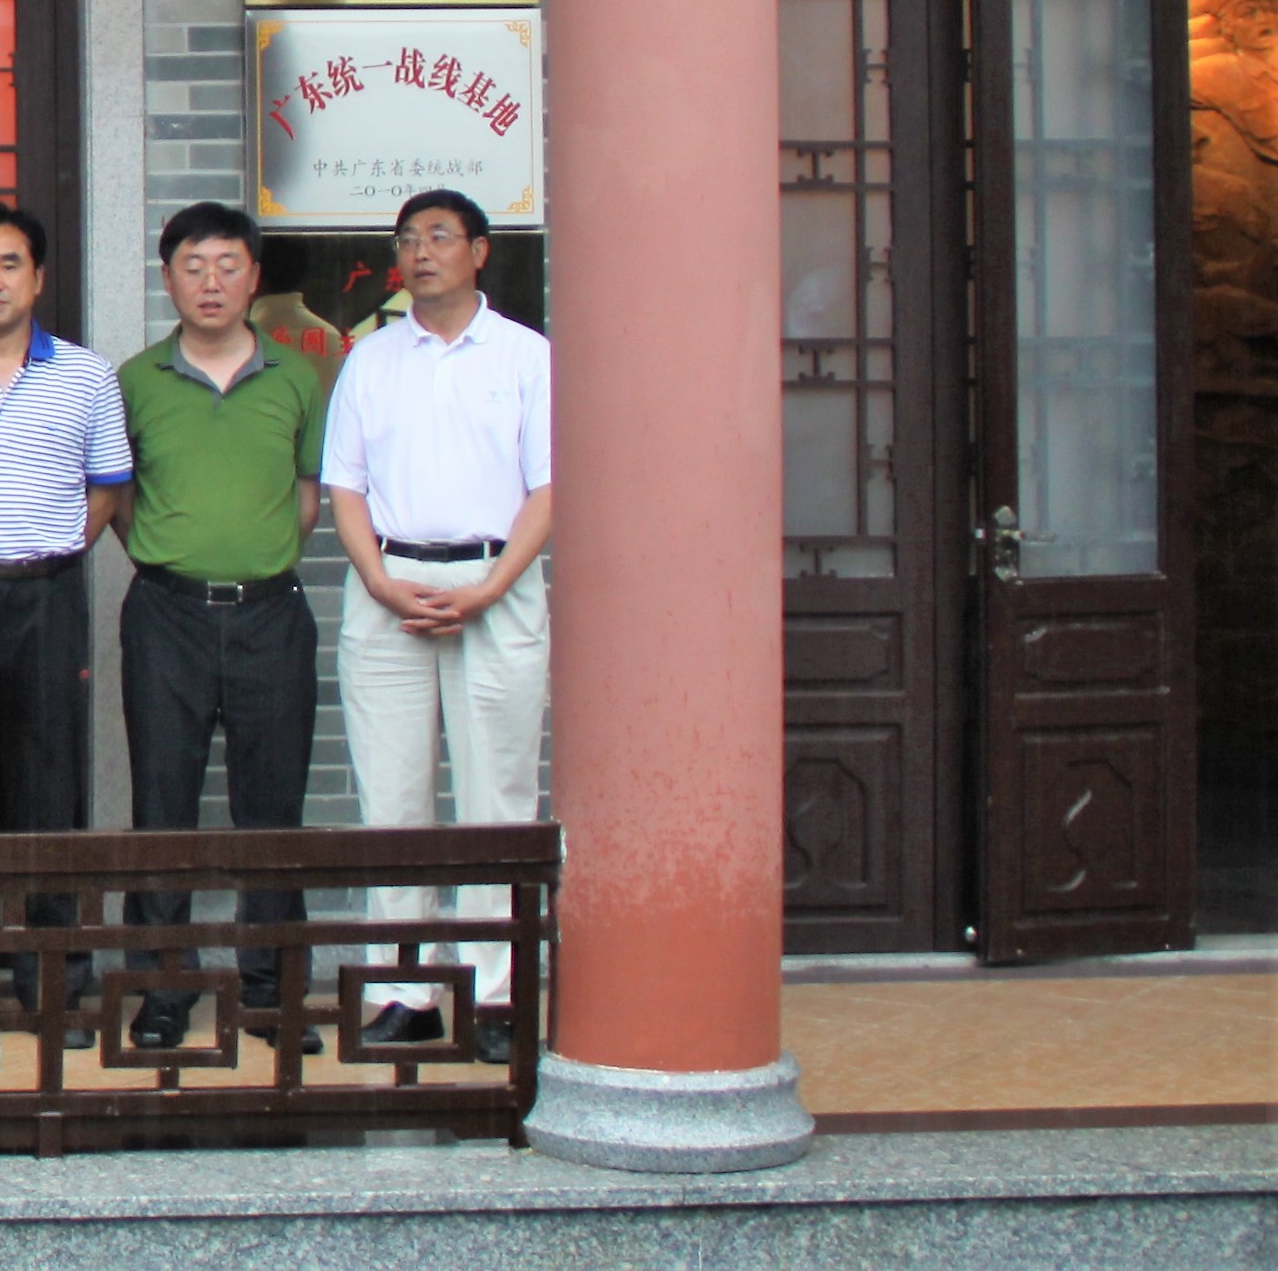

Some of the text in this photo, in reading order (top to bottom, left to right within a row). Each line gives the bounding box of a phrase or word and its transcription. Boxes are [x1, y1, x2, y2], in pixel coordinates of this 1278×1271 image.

[269, 47, 521, 139] 广东统一战线基地
[312, 158, 484, 178] 中共广东省委统战部
